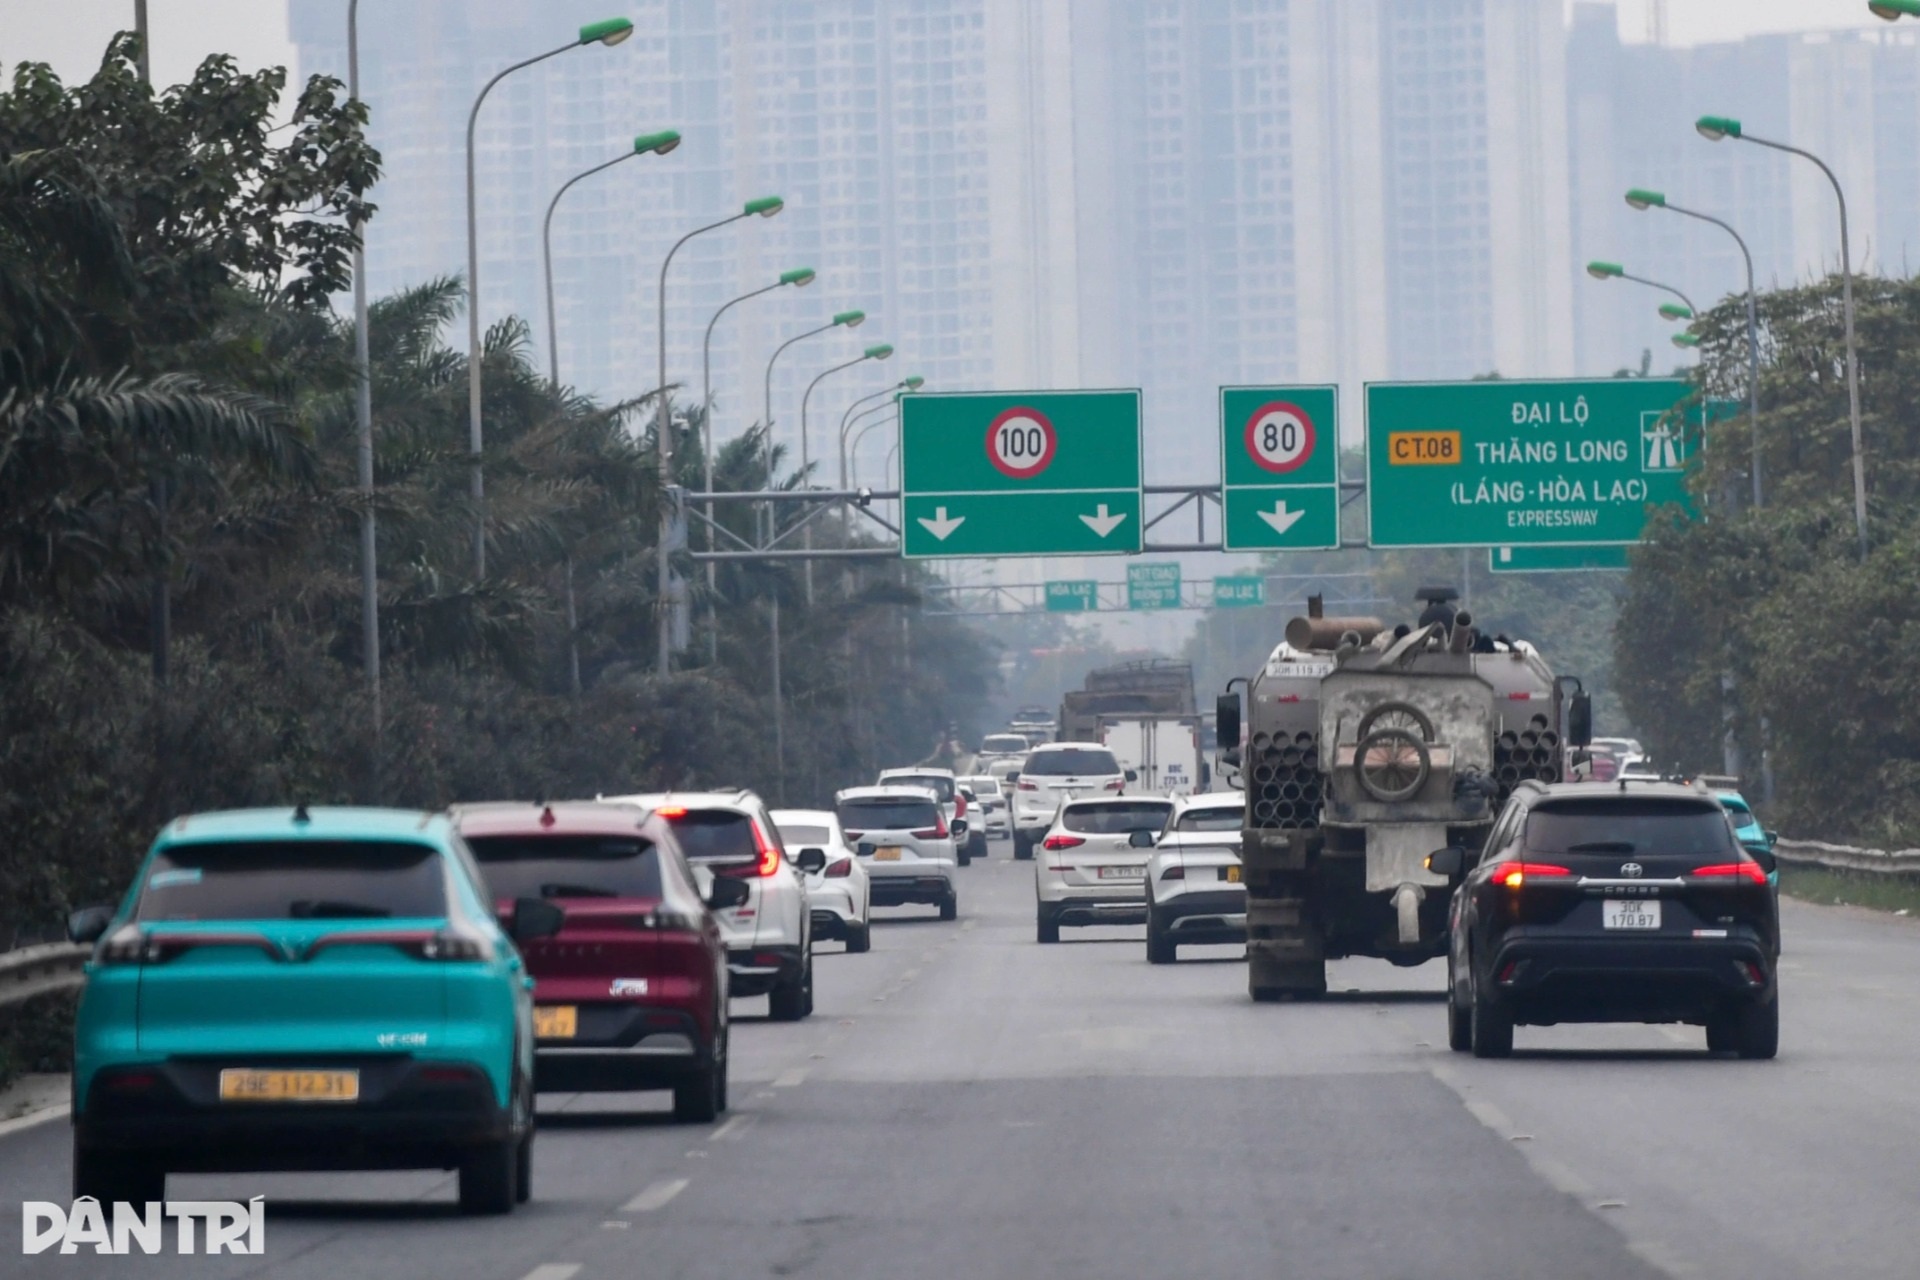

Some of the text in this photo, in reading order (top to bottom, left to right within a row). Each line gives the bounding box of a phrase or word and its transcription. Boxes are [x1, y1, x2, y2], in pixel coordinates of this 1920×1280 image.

[1511, 395, 1590, 428] ĐẠI LỘ
[1000, 427, 1043, 458] 100
[1263, 423, 1296, 452] 80
[1395, 437, 1453, 459] CT.08
[1475, 437, 1628, 465] THĂNG LONG
[1593, 479, 1648, 506] LẠC)
[1507, 509, 1599, 527] EXPRESSWAY
[1620, 901, 1644, 914] 30K
